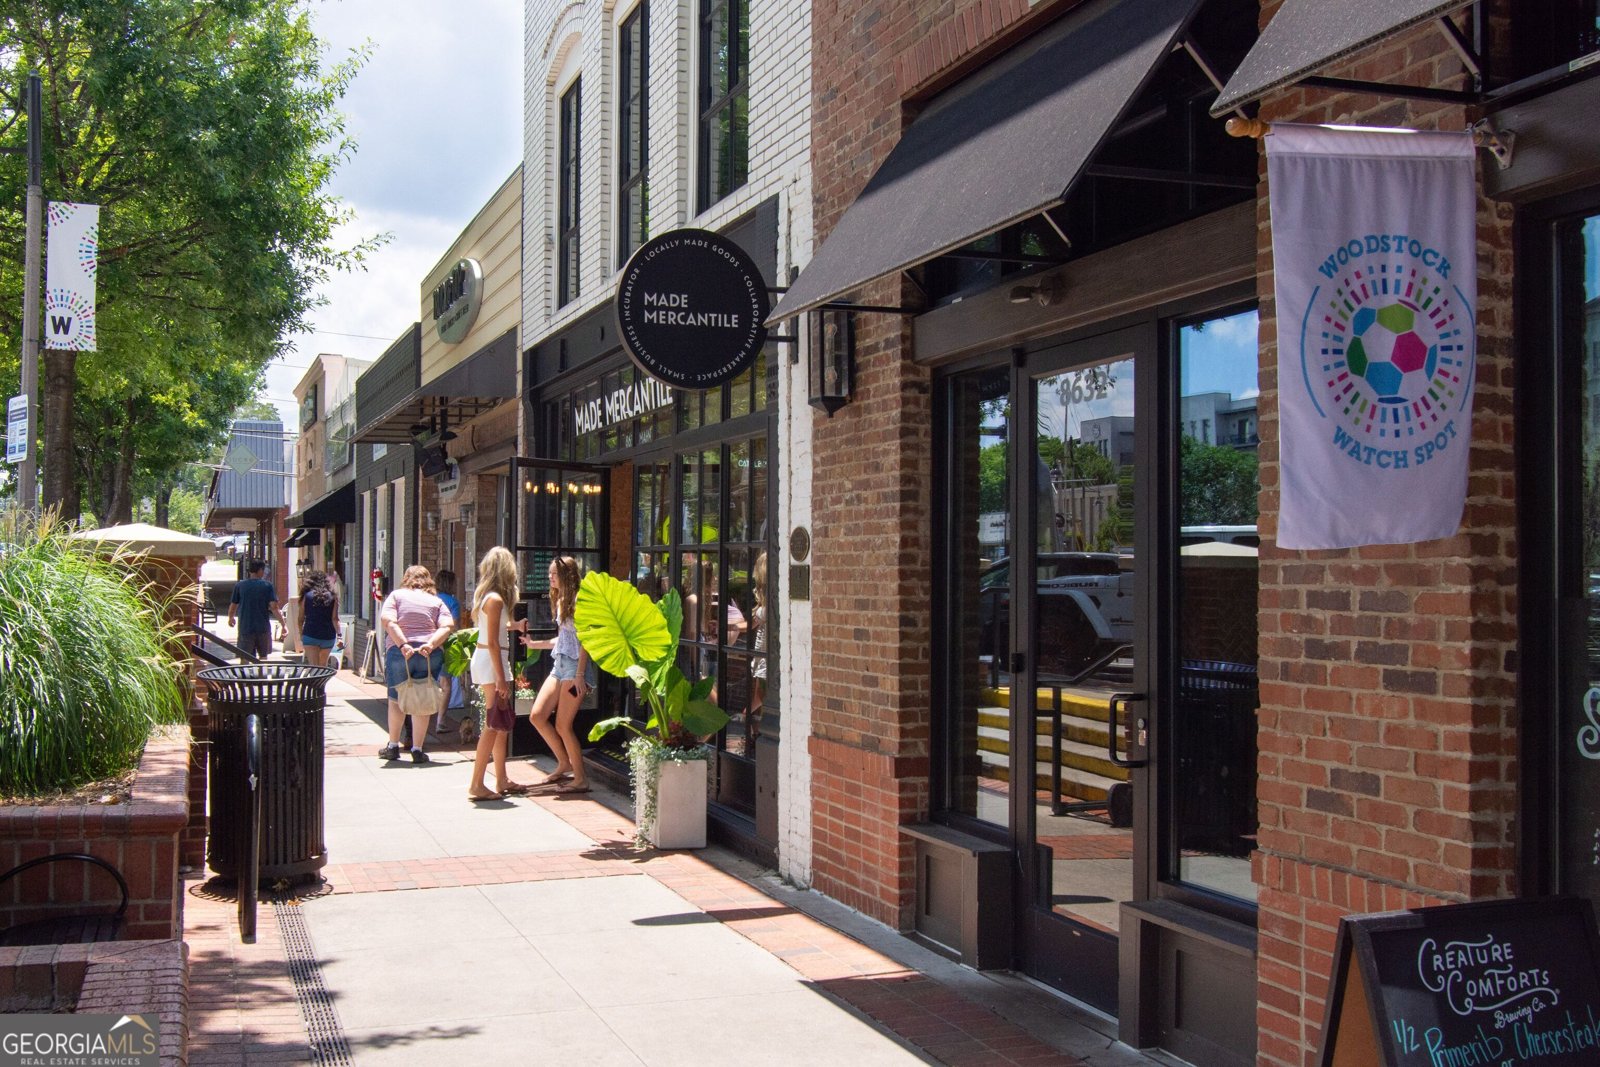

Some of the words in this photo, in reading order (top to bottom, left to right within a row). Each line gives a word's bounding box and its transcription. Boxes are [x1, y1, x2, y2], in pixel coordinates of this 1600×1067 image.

[644, 239, 679, 261] LOCALLY
[684, 239, 708, 248] MADE
[711, 244, 740, 268] GOODS
[1318, 234, 1452, 280] WOODSTOCK
[624, 267, 640, 321] INCUBATOR
[644, 292, 689, 308] MADE
[743, 275, 760, 348] COLLABORATIVE
[51, 315, 72, 336] W
[644, 310, 739, 328] MERCANTILE
[627, 325, 656, 365] BUSINESS
[658, 364, 685, 380] SMALL
[697, 350, 747, 381] MAKERSPACE
[575, 398, 602, 436] MADE
[605, 376, 673, 426] MERCANTILE
[1060, 370, 1108, 407] 8632
[1332, 424, 1409, 469] WATCH
[1415, 419, 1457, 465] SPOT
[1418, 934, 1515, 992] CREATURE
[1447, 963, 1551, 1015] COMFORTS
[1494, 1004, 1533, 1029] Brewing
